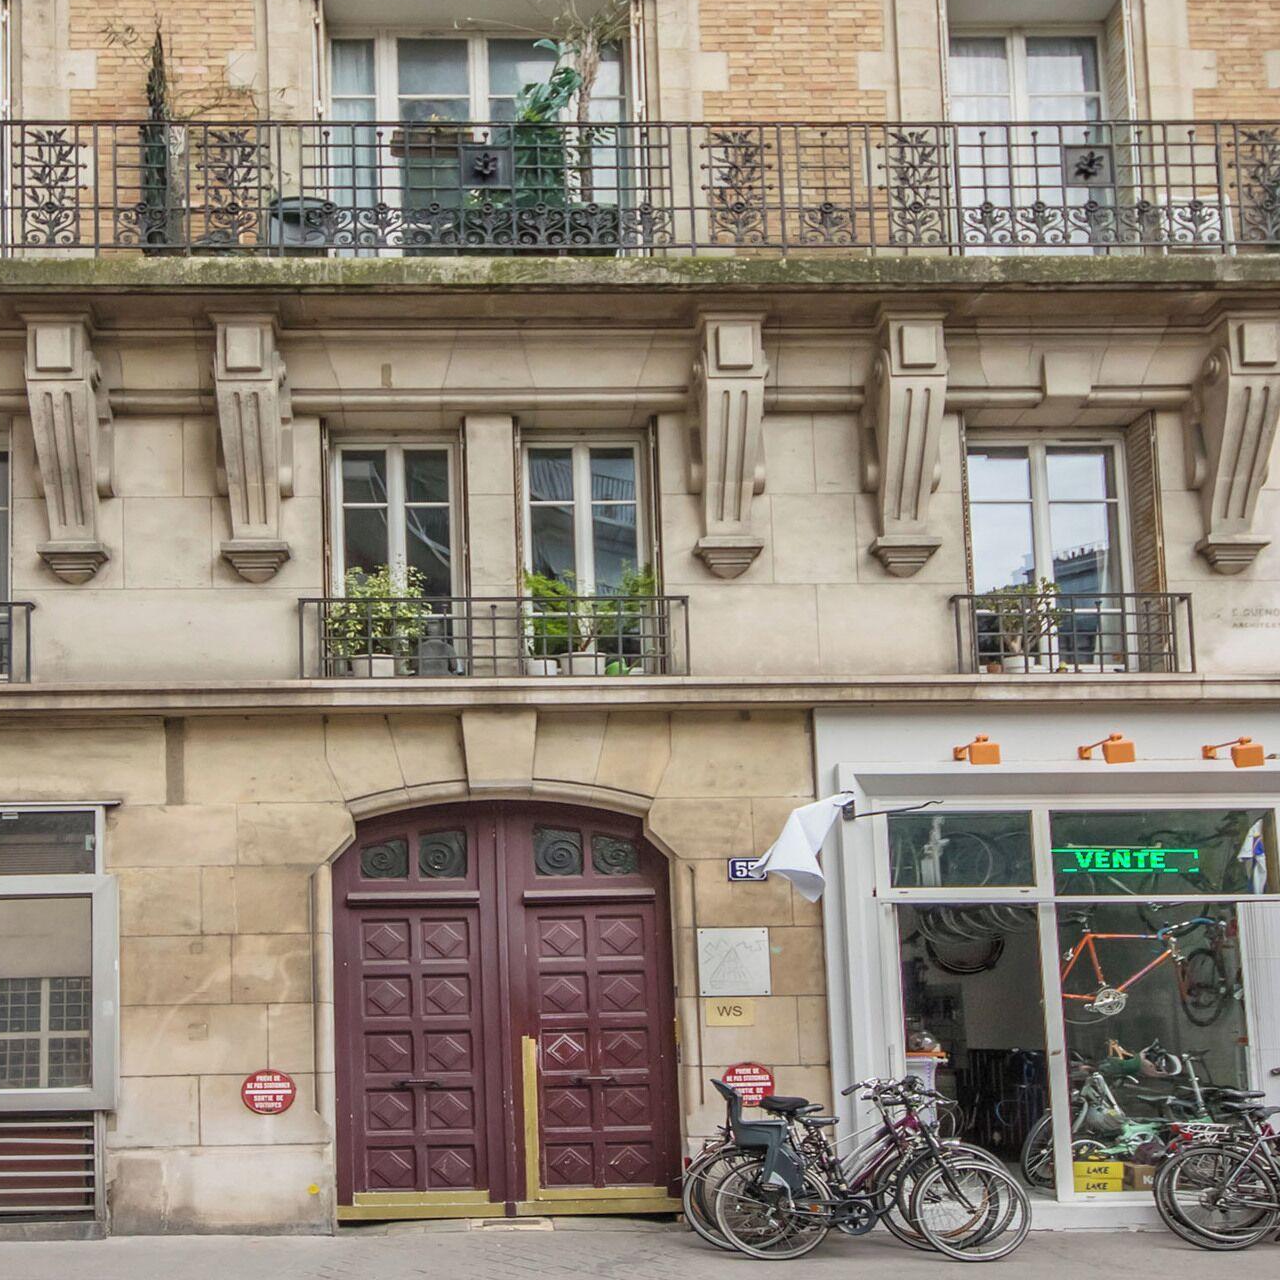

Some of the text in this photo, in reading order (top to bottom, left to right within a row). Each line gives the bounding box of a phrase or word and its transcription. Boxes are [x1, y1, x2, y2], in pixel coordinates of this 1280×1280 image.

[1075, 850, 1166, 869] VENTE
[717, 1005, 743, 1017] WS
[253, 1094, 284, 1102] SORTIE DE
[1086, 1166, 1109, 1175] LAKE
[1086, 1182, 1108, 1190] LAKE
